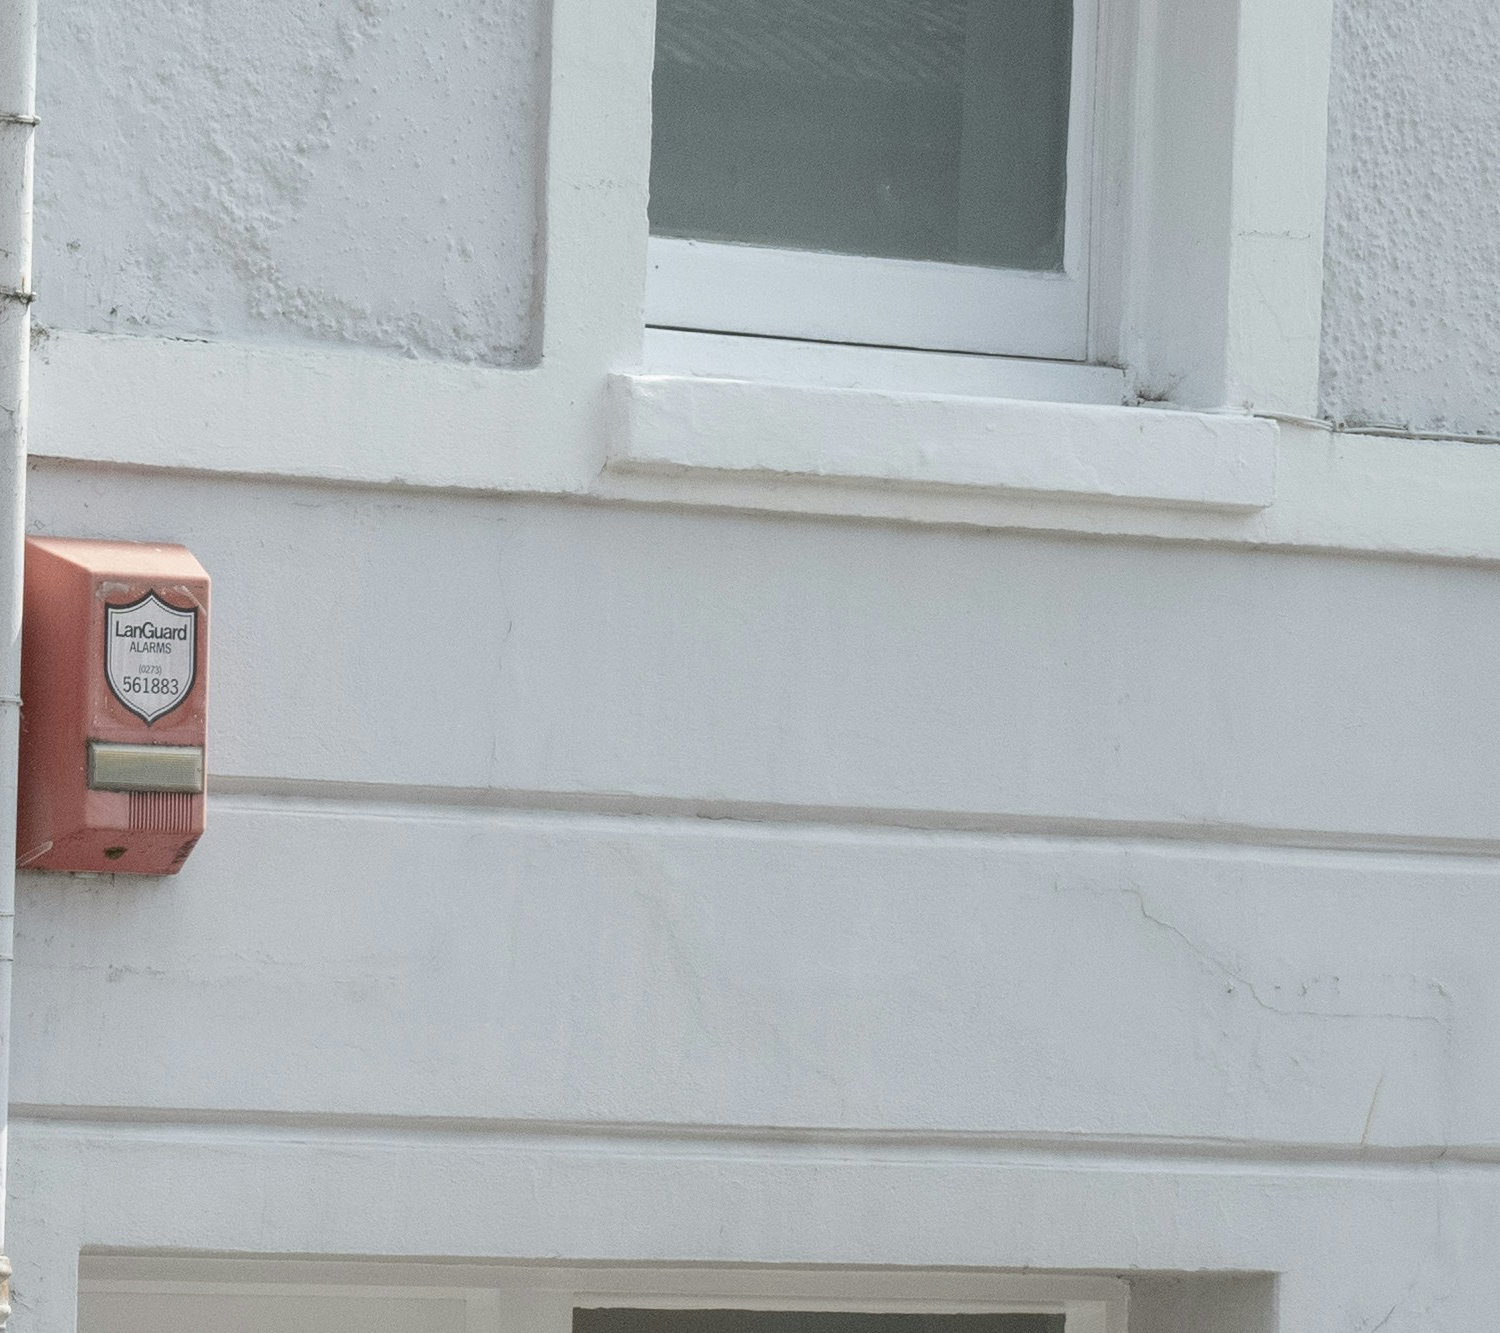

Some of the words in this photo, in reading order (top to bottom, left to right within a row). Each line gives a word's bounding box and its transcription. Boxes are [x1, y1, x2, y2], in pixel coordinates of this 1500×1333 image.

[115, 621, 187, 640] LanGuard
[129, 642, 171, 654] ALARMS
[139, 665, 162, 675] (0273)
[123, 676, 178, 695] 561883
